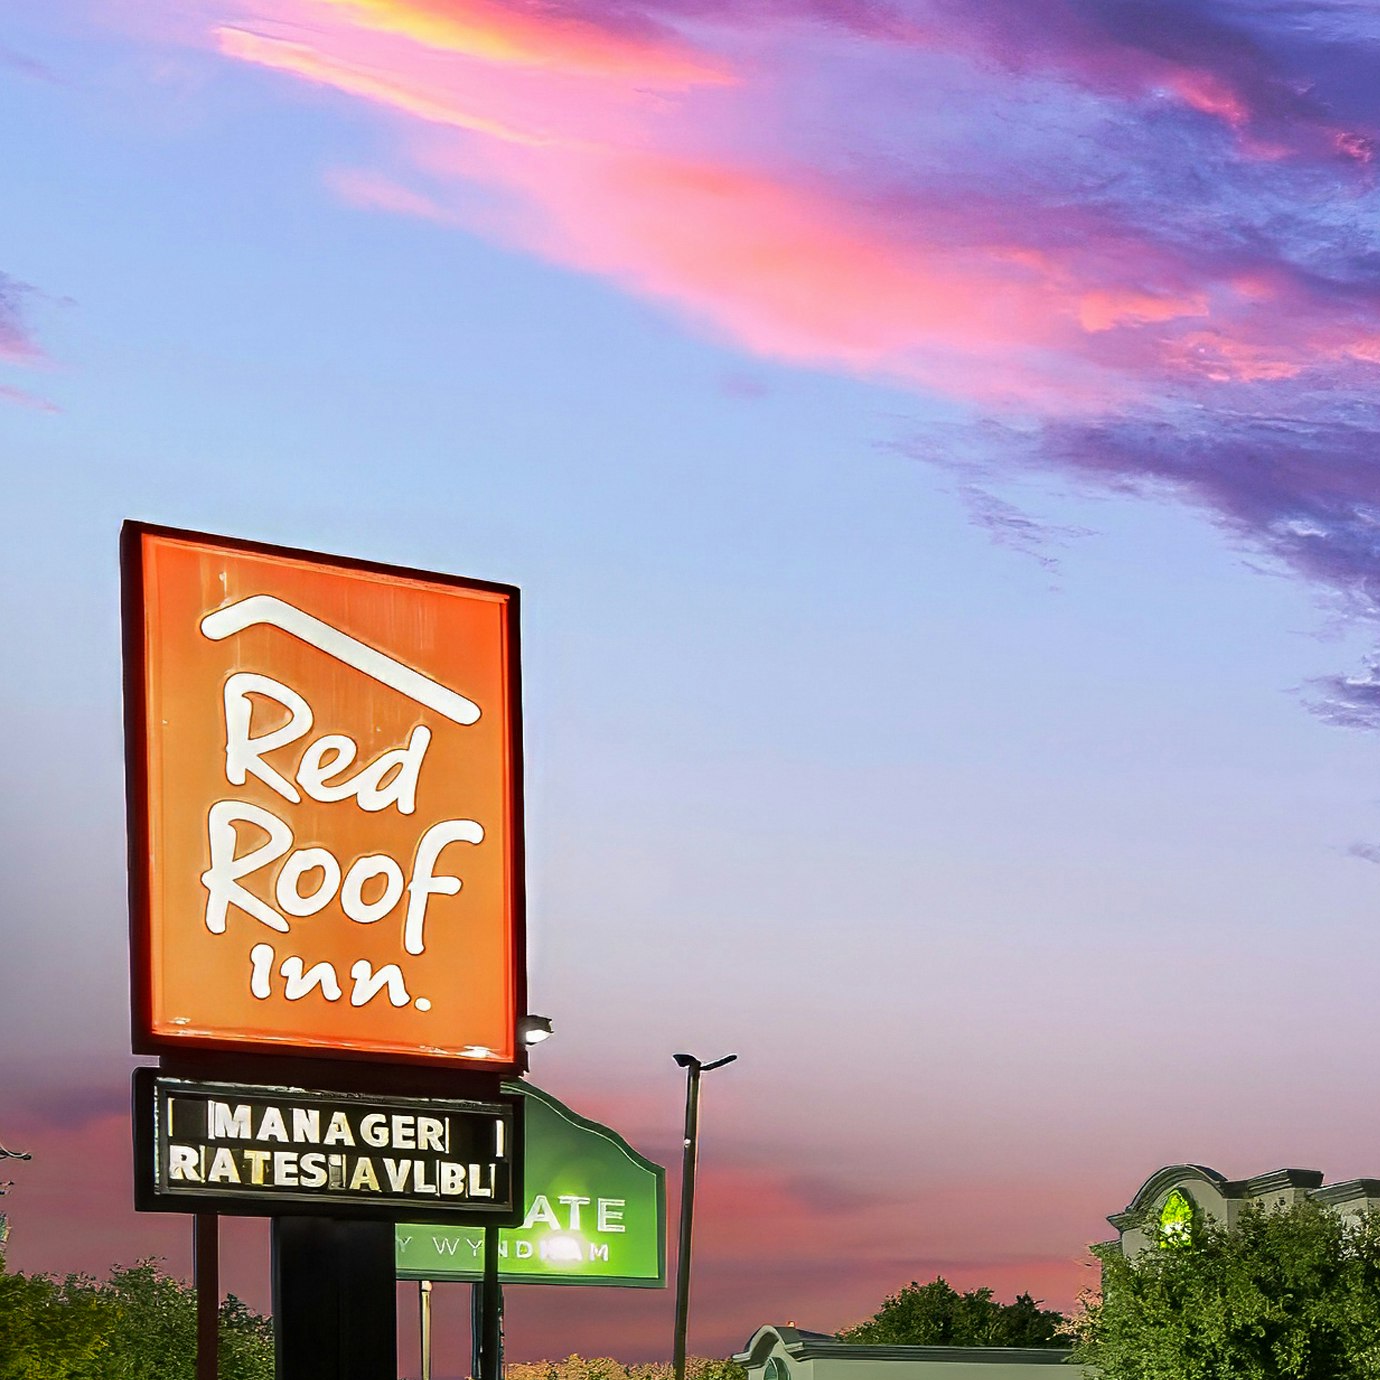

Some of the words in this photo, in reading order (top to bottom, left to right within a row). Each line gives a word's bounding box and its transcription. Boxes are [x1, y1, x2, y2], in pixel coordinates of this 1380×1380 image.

[225, 672, 432, 815] Red
[201, 799, 485, 955] Roof
[169, 1145, 328, 1188] RATES
[350, 1156, 493, 1198] AVLBL
[213, 1101, 447, 1152] MANAGER
